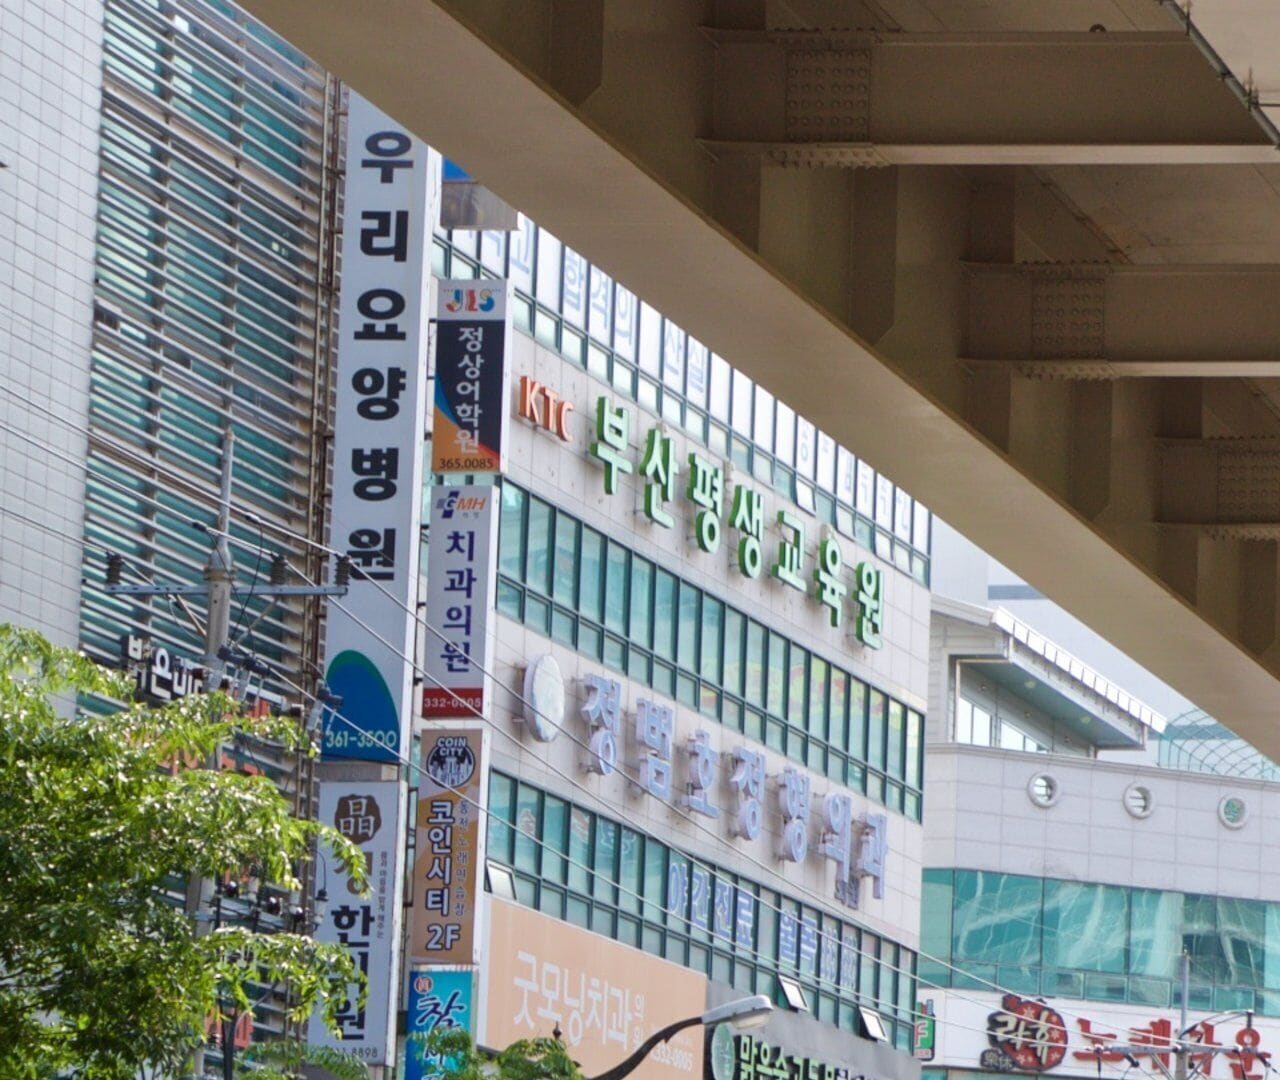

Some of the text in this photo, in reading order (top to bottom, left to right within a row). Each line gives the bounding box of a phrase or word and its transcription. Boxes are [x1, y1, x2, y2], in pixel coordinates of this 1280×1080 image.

[347, 130, 414, 582] 우리요양병원
[455, 327, 484, 454] 정상어학원
[518, 375, 574, 442] KTC
[589, 396, 885, 650] 부산평생교육원
[440, 530, 477, 673] 치과의원
[325, 730, 397, 749] 361-3500
[437, 737, 467, 749] COIN
[579, 672, 888, 900] 정범호정형외과
[425, 800, 455, 917] 코인시티
[426, 924, 462, 950] 2F
[513, 950, 633, 1050] 굿모닝치과
